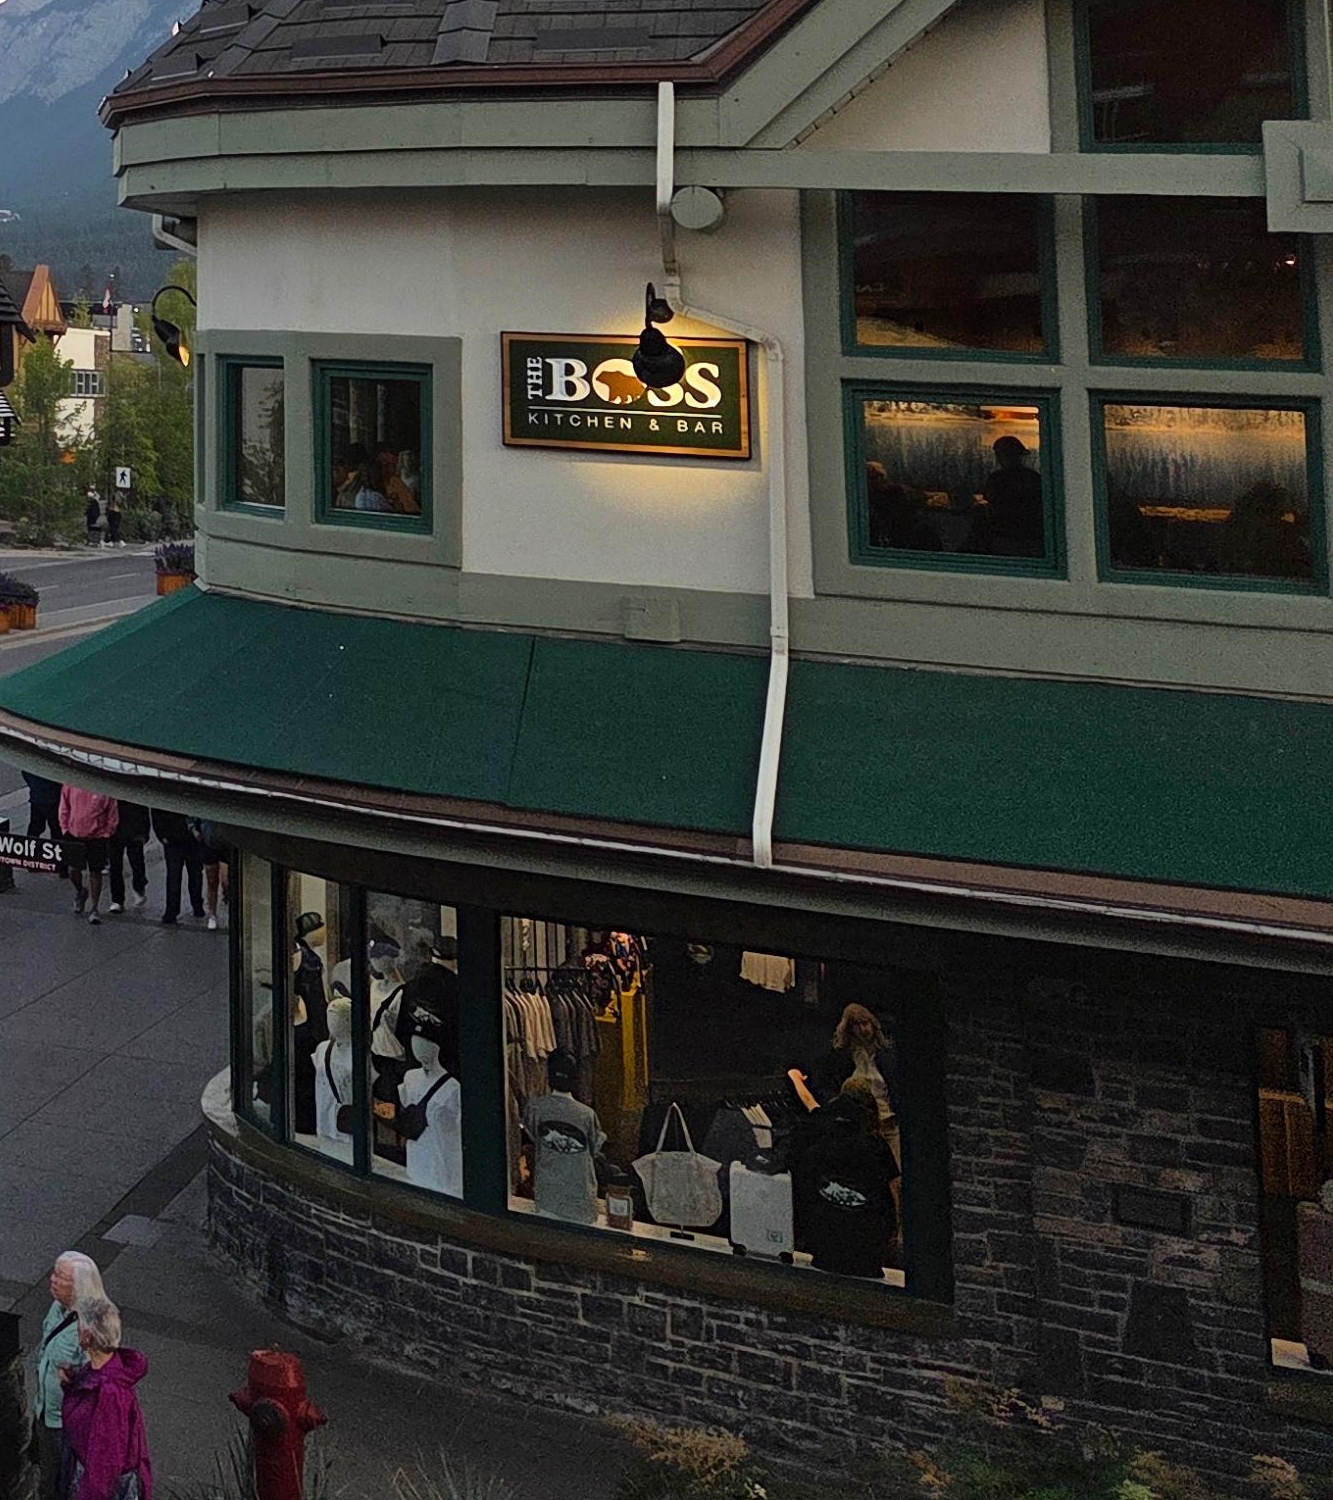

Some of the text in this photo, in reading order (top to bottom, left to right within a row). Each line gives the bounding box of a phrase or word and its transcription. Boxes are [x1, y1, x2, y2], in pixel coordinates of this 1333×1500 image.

[527, 356, 543, 400] THE
[528, 412, 723, 435] KITCHEN & BAR
[42, 842, 62, 861] St
[23, 860, 56, 871] DISTRICT
